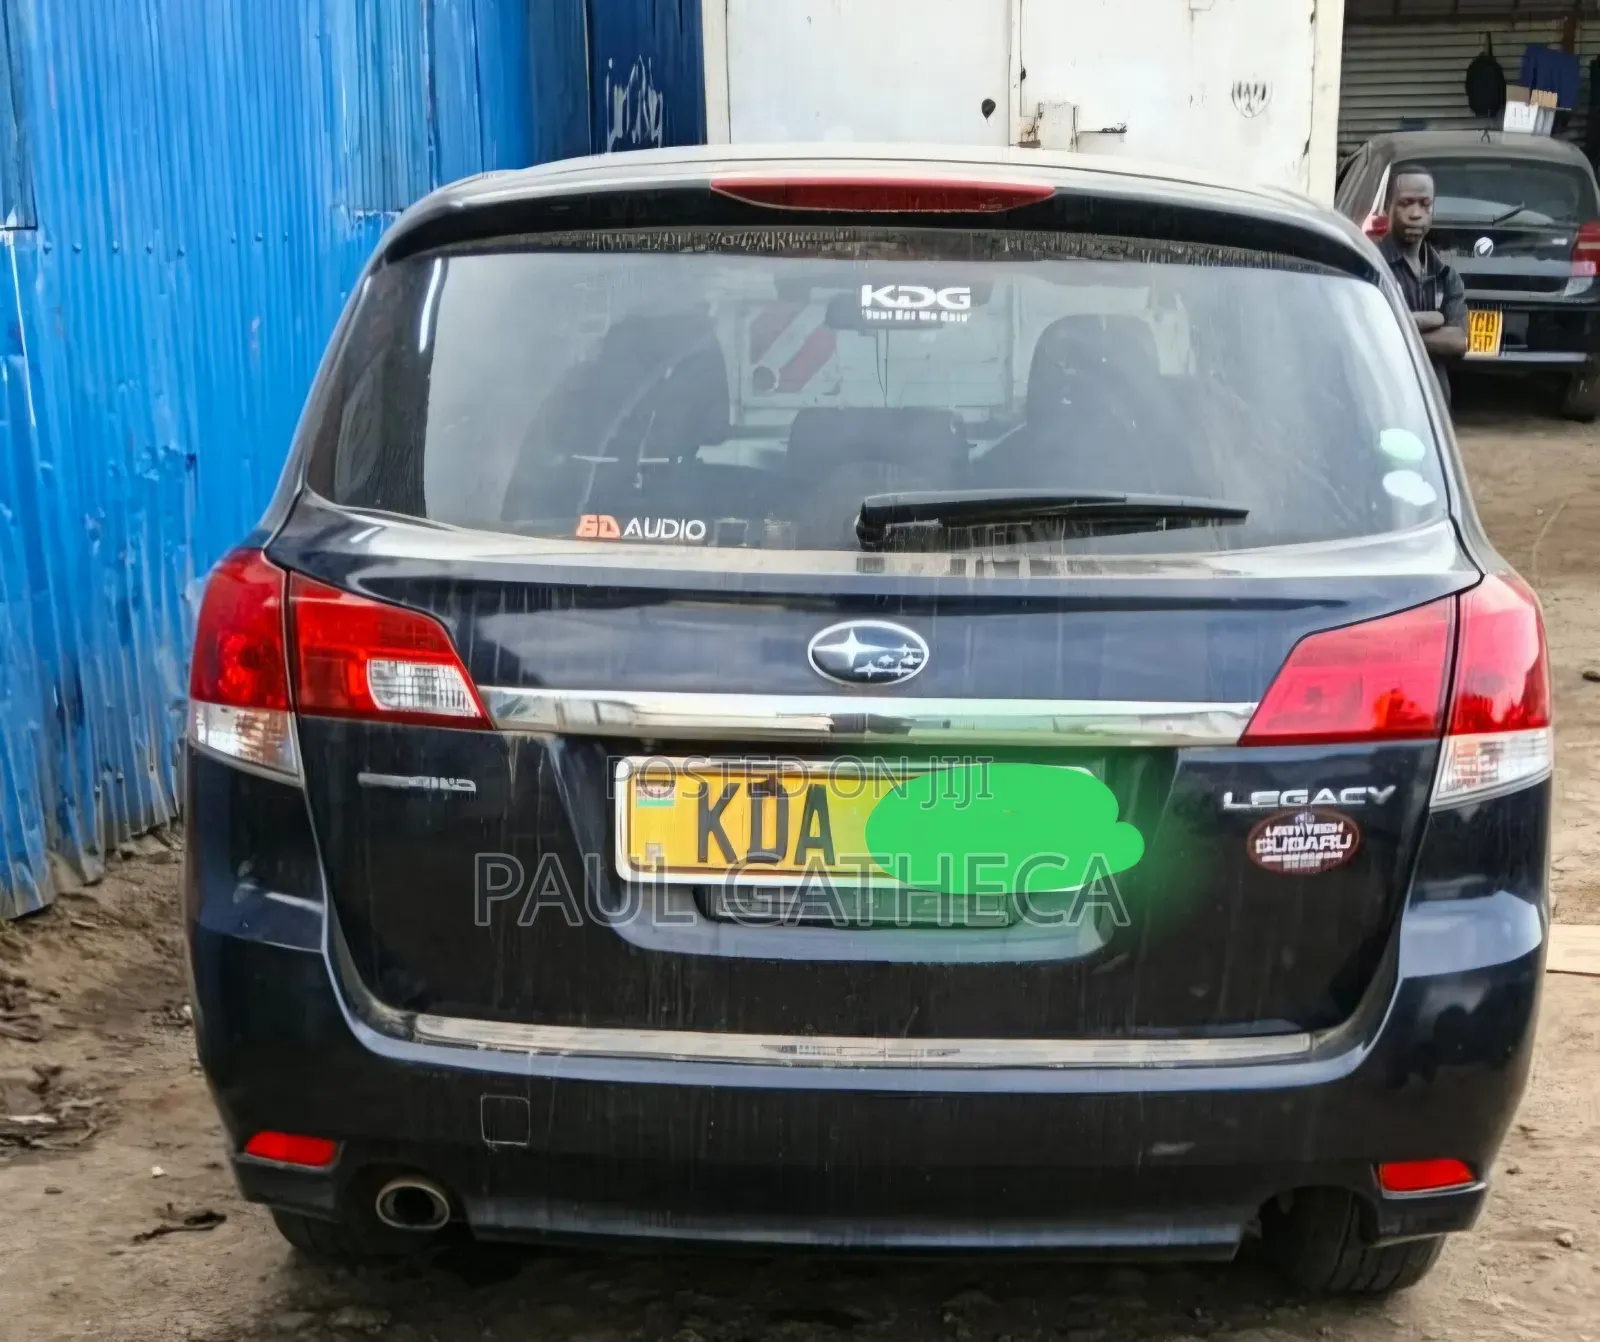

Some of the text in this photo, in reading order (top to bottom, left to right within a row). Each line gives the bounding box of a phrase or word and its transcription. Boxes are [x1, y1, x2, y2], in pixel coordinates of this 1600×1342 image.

[861, 284, 971, 310] KDG
[621, 517, 707, 541] AUDIO
[1223, 785, 1397, 811] LEGACY
[696, 782, 836, 866] KDA
